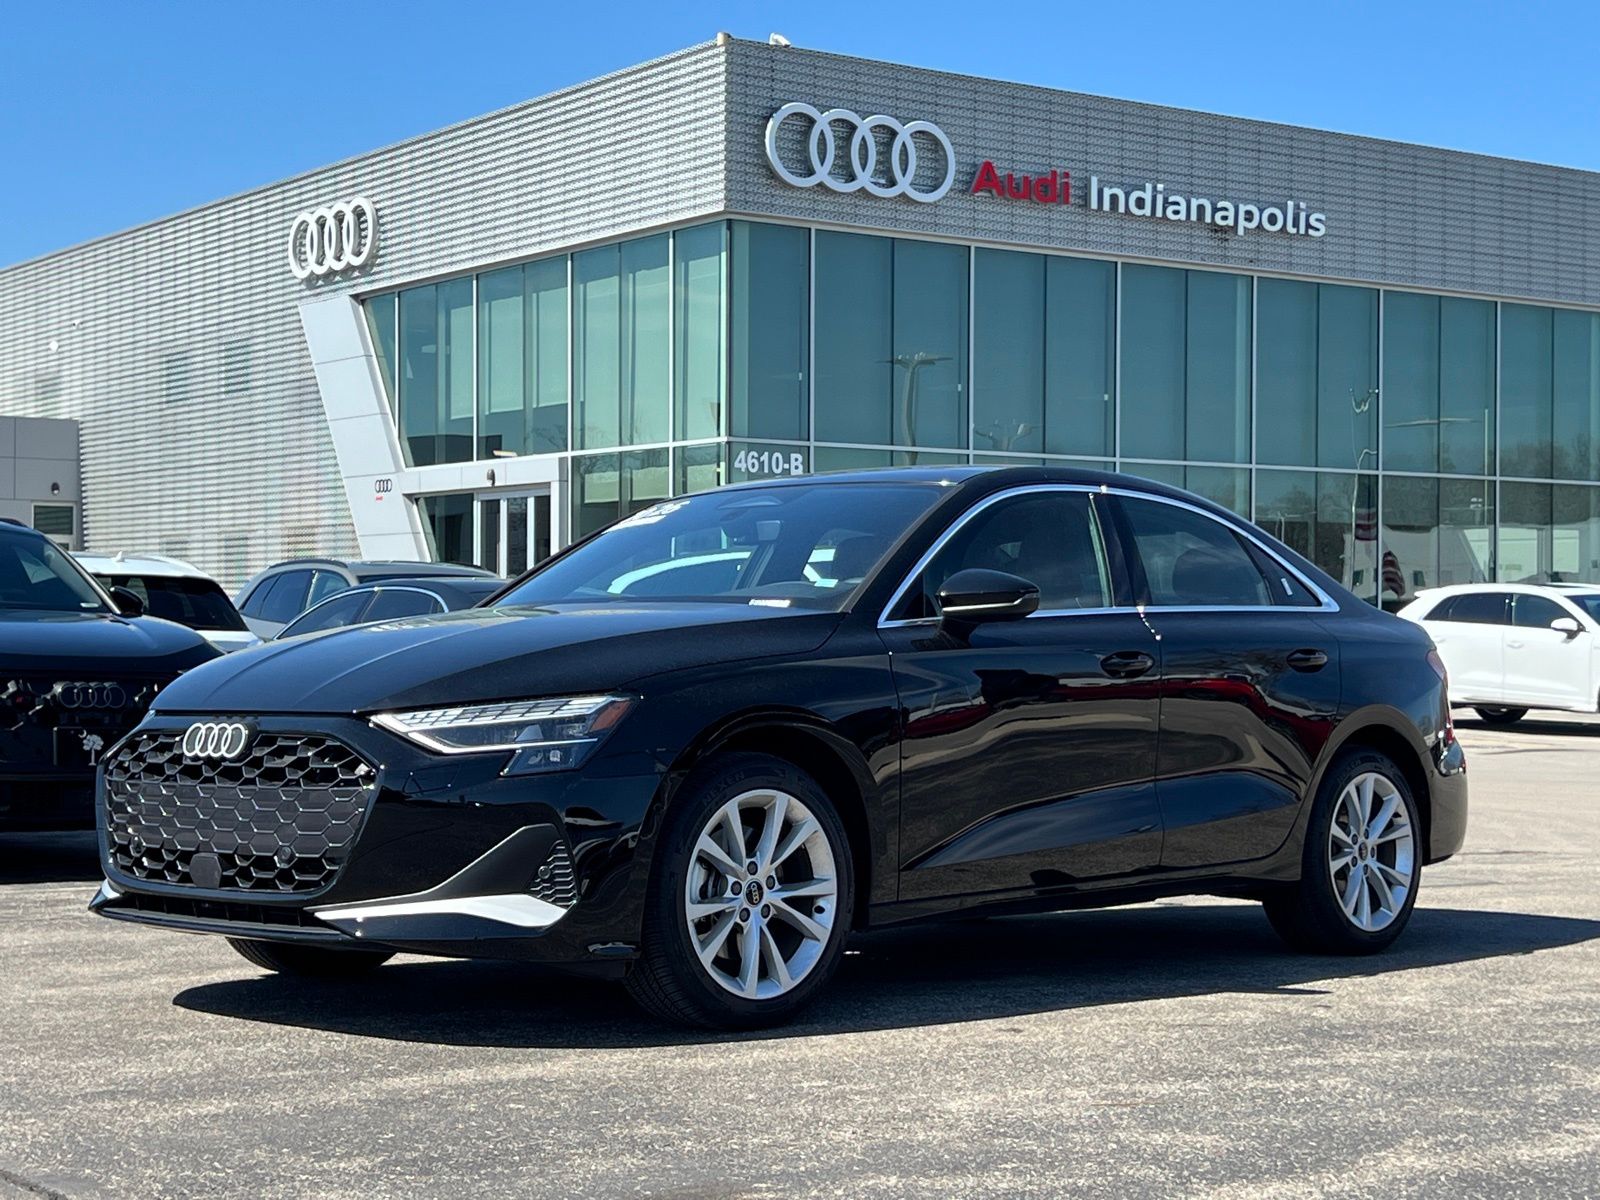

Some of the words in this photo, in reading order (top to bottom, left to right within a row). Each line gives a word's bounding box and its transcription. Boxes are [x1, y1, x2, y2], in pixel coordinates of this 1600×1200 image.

[970, 159, 1072, 205] Audi
[1088, 175, 1327, 237] Indianapolis
[733, 450, 804, 476] 4610-B
